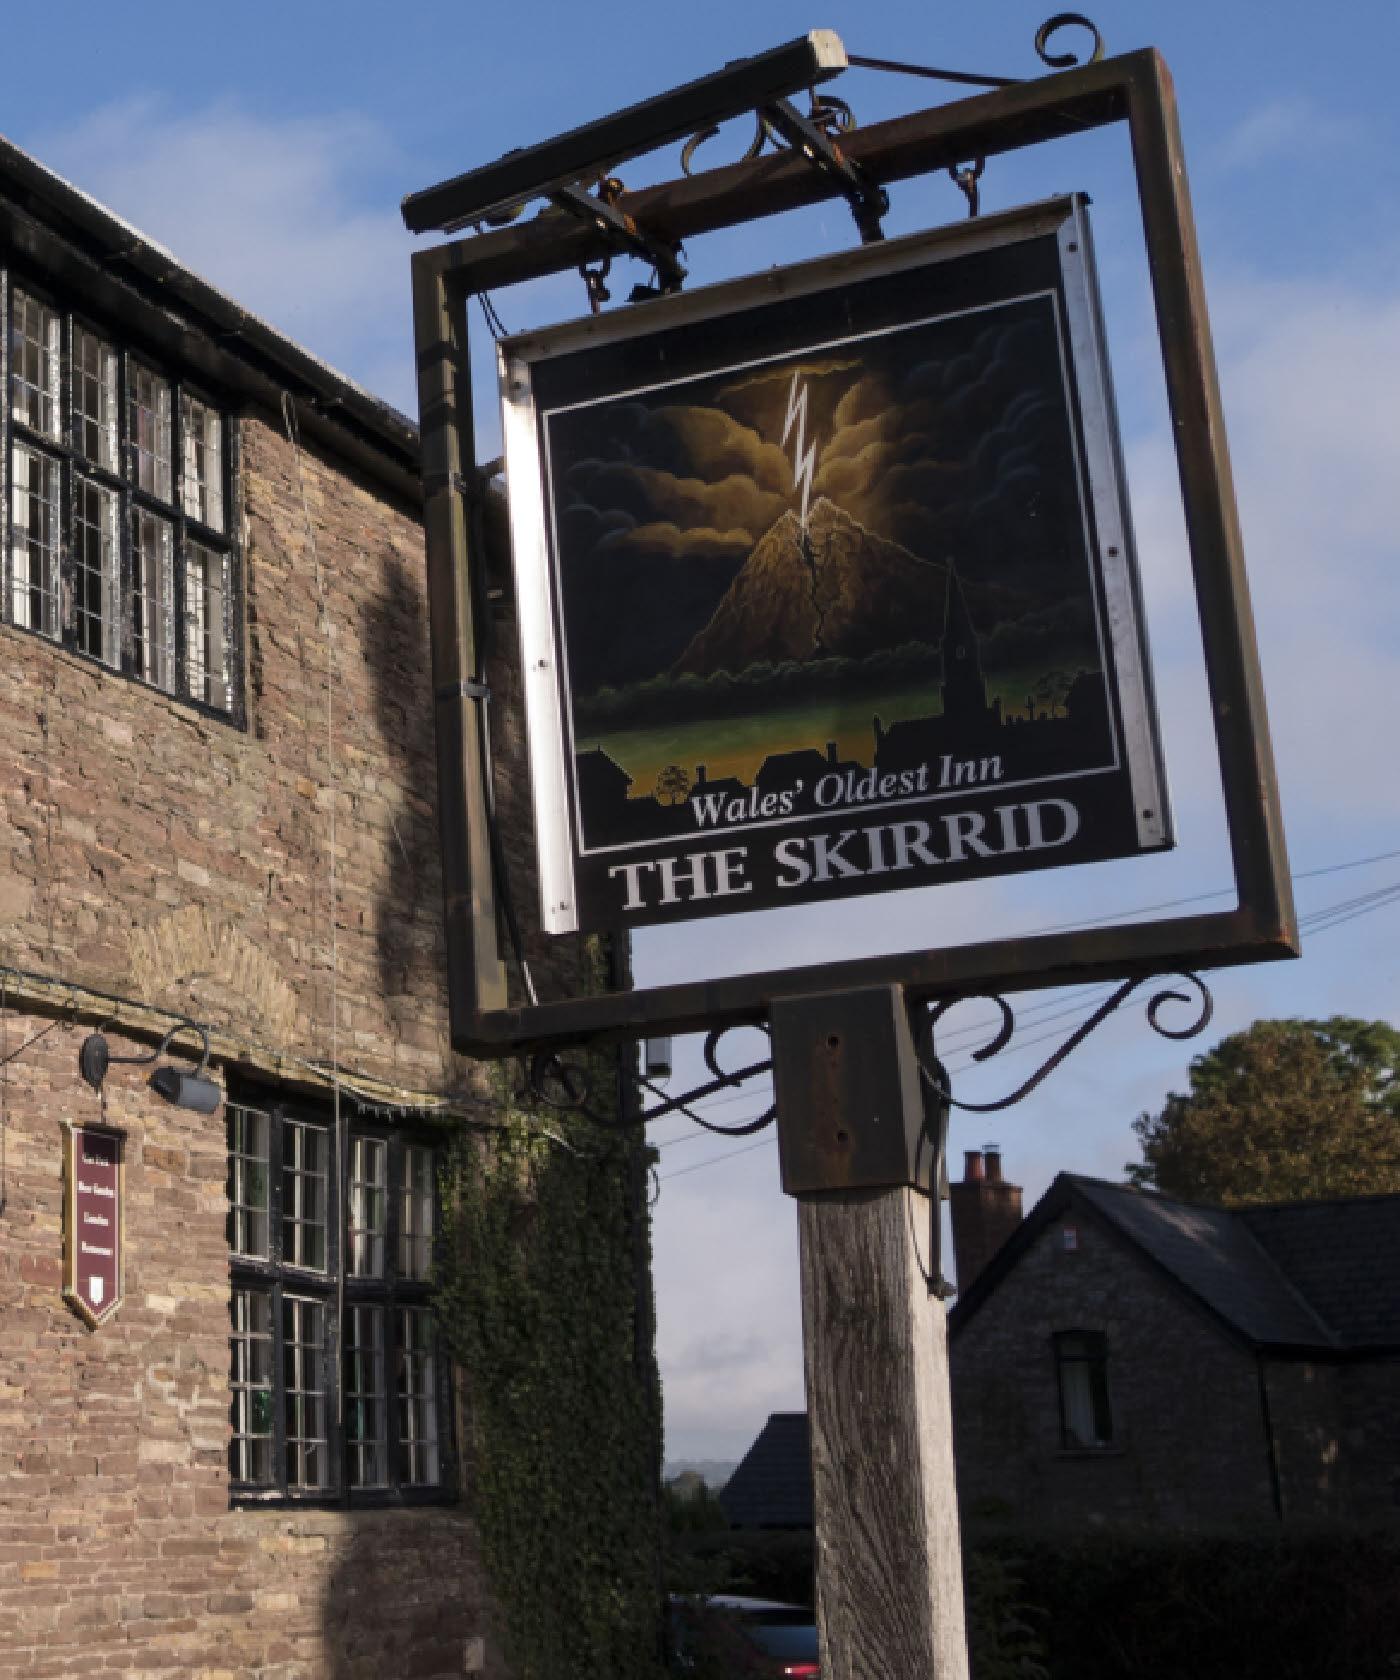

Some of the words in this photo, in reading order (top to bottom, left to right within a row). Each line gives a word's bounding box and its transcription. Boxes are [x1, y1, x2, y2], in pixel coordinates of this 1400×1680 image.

[814, 762, 929, 807] Oldest
[937, 754, 1004, 788] Inn
[608, 847, 753, 910] THE
[774, 799, 1080, 887] SKIRRID
